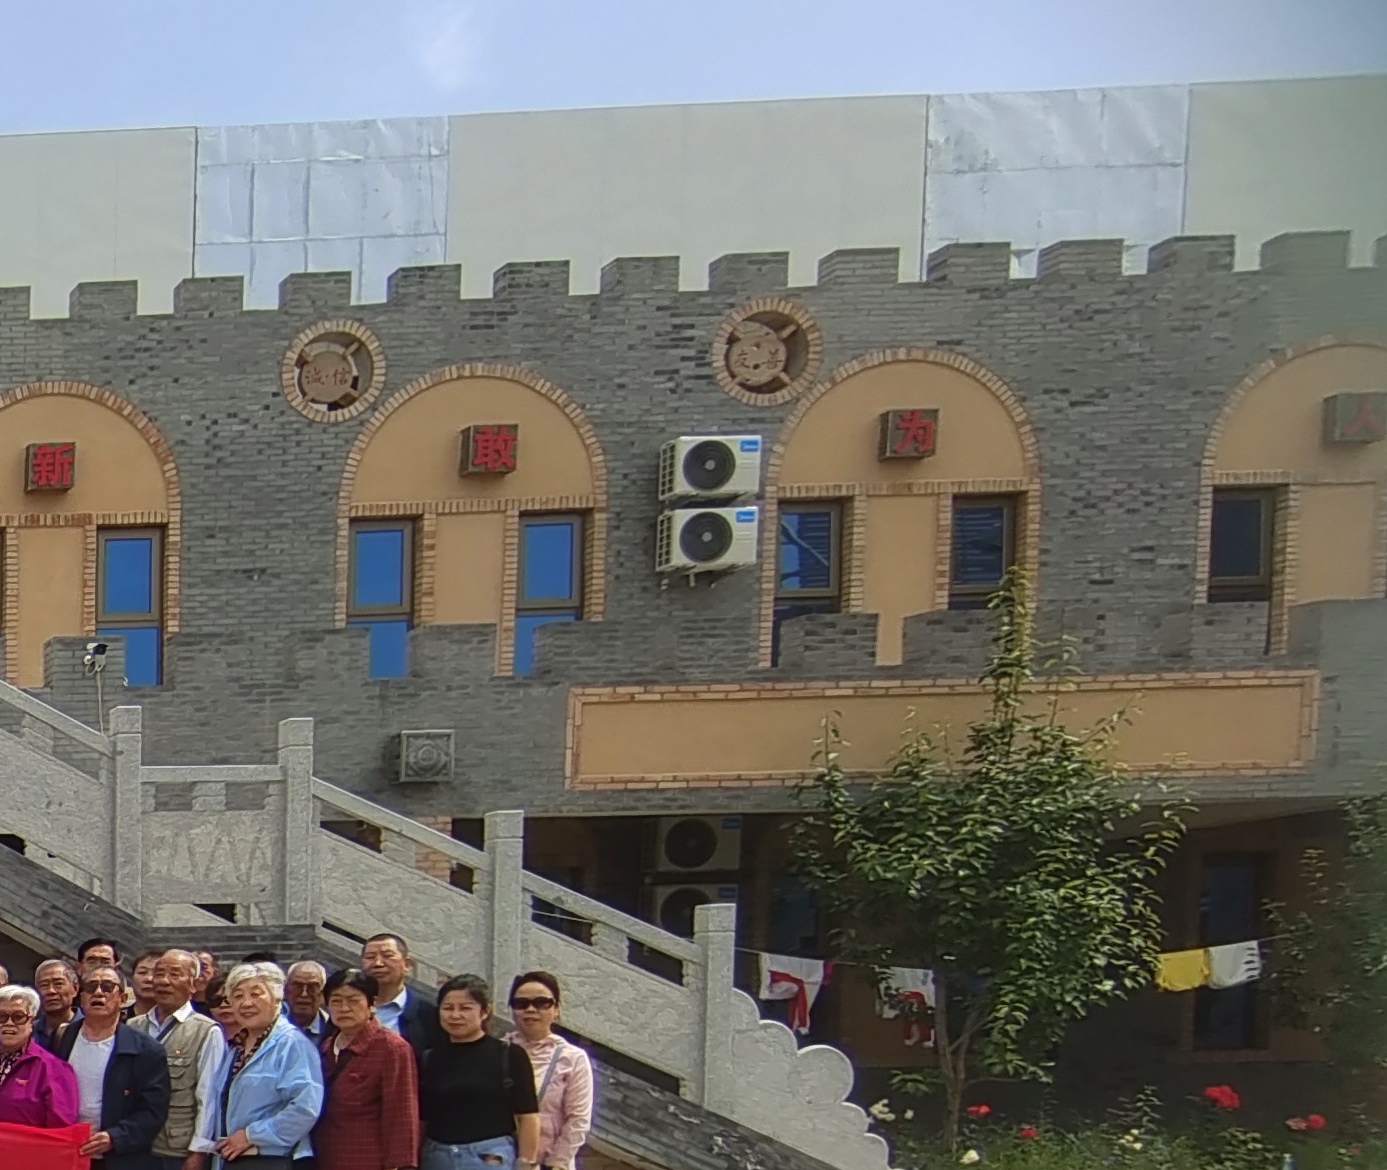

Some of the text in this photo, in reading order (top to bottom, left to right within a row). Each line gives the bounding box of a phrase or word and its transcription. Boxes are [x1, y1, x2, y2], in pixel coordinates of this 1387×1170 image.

[474, 427, 515, 469] 敢
[894, 410, 933, 454] 为
[33, 443, 74, 487] 新
